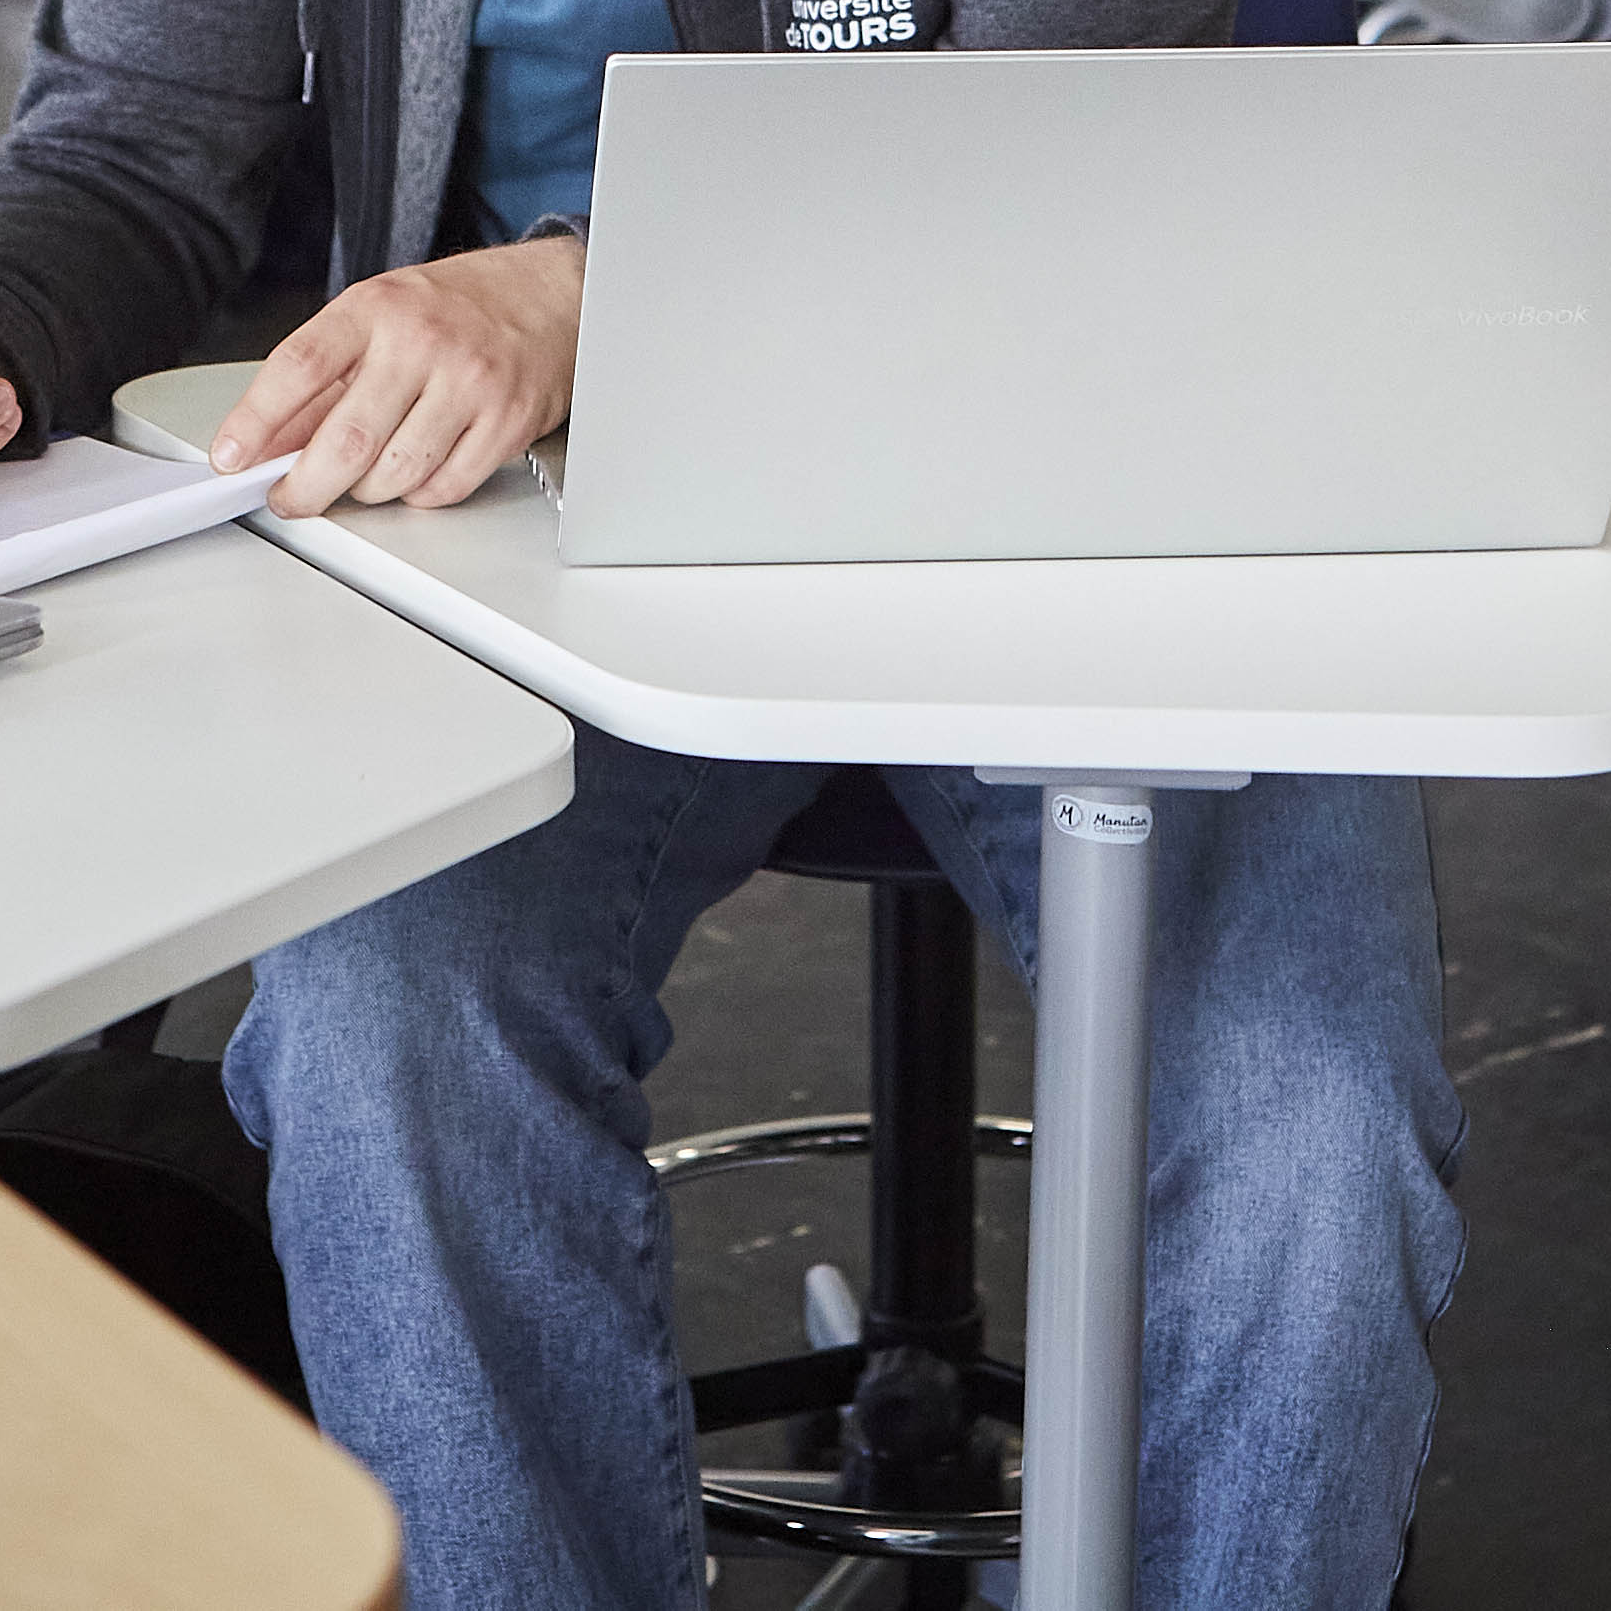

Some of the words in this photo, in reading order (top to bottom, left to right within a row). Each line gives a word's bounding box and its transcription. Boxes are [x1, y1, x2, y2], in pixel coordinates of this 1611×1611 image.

[801, 12, 917, 52] TOURS
[1059, 803, 1074, 826] M
[1092, 813, 1149, 827] Manutan
